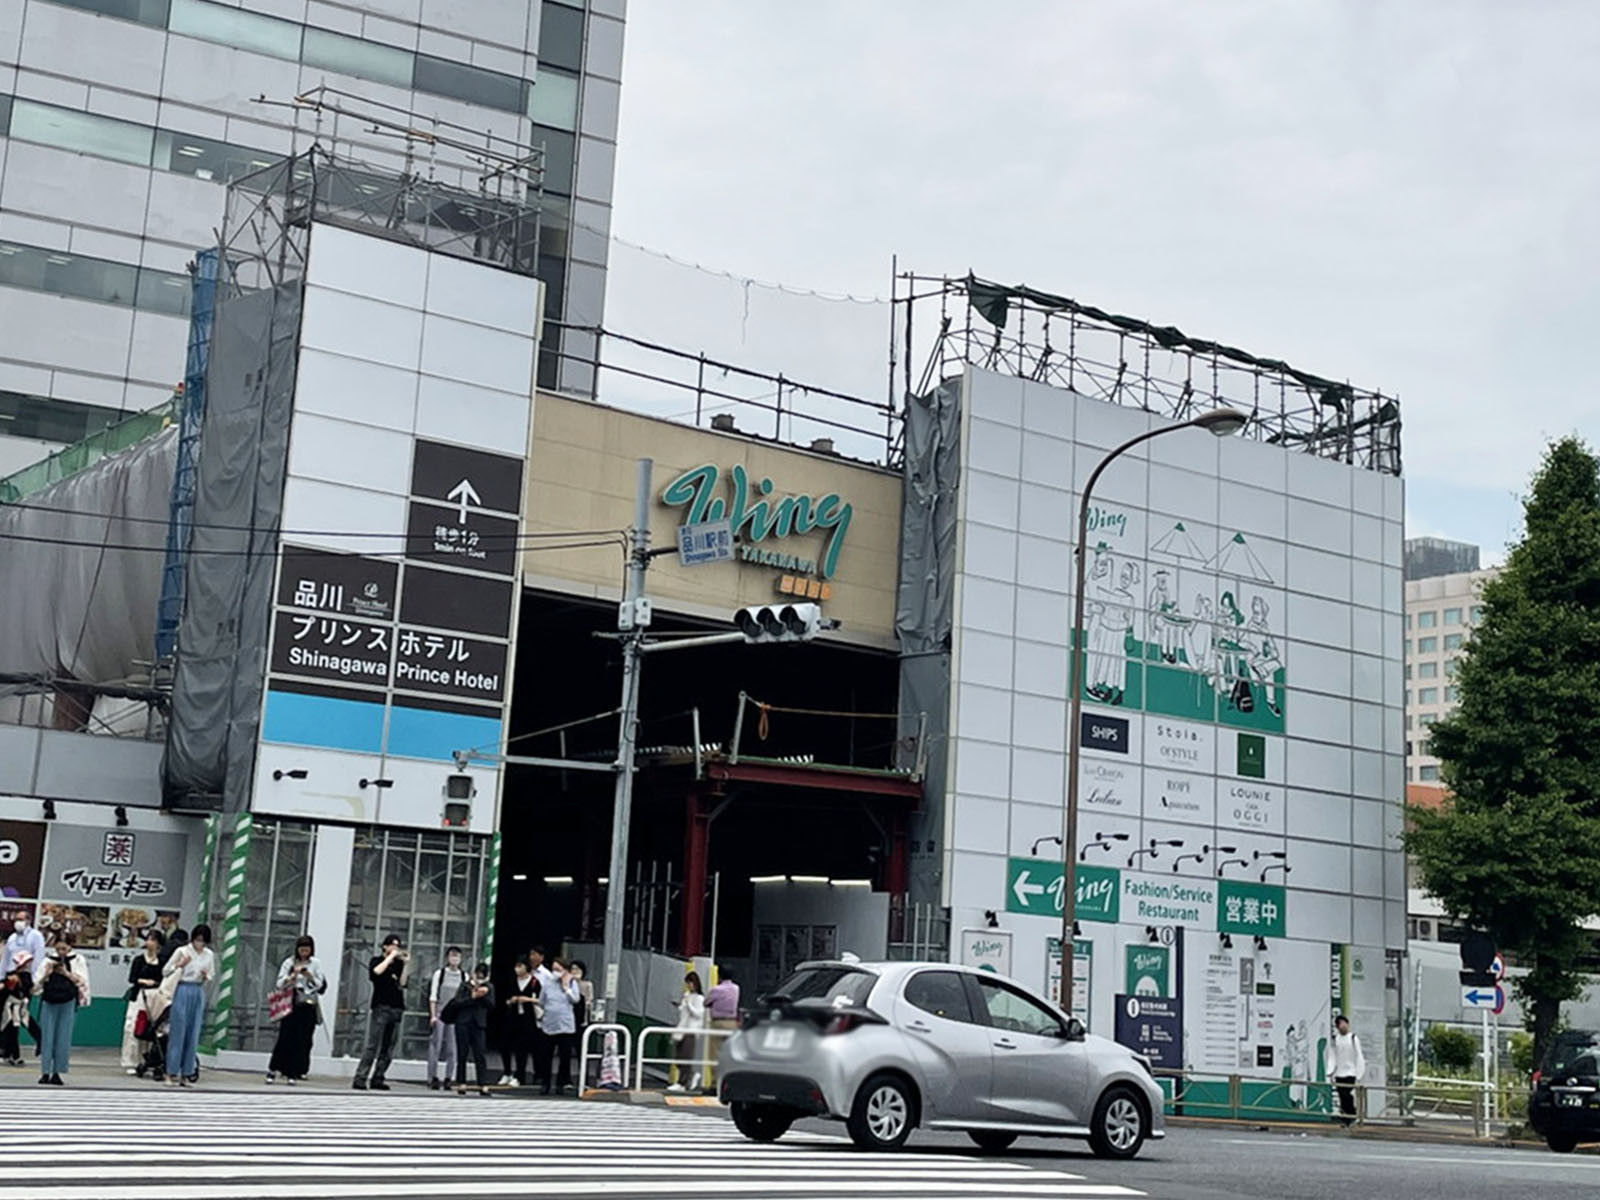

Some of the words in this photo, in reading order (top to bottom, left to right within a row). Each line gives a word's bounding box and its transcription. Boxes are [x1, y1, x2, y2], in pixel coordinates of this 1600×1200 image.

[294, 580, 343, 611] 品川
[289, 648, 387, 676] Shinagawa
[397, 662, 449, 684] Prince
[455, 670, 498, 691] Hotel
[1091, 725, 1118, 742] SHIPS
[106, 834, 131, 863] 薬
[62, 868, 165, 898] マツモトキヨシ
[1125, 879, 1213, 904] Fashion/Service
[1138, 900, 1199, 921] Restaurant
[1225, 896, 1278, 925] 営業中
